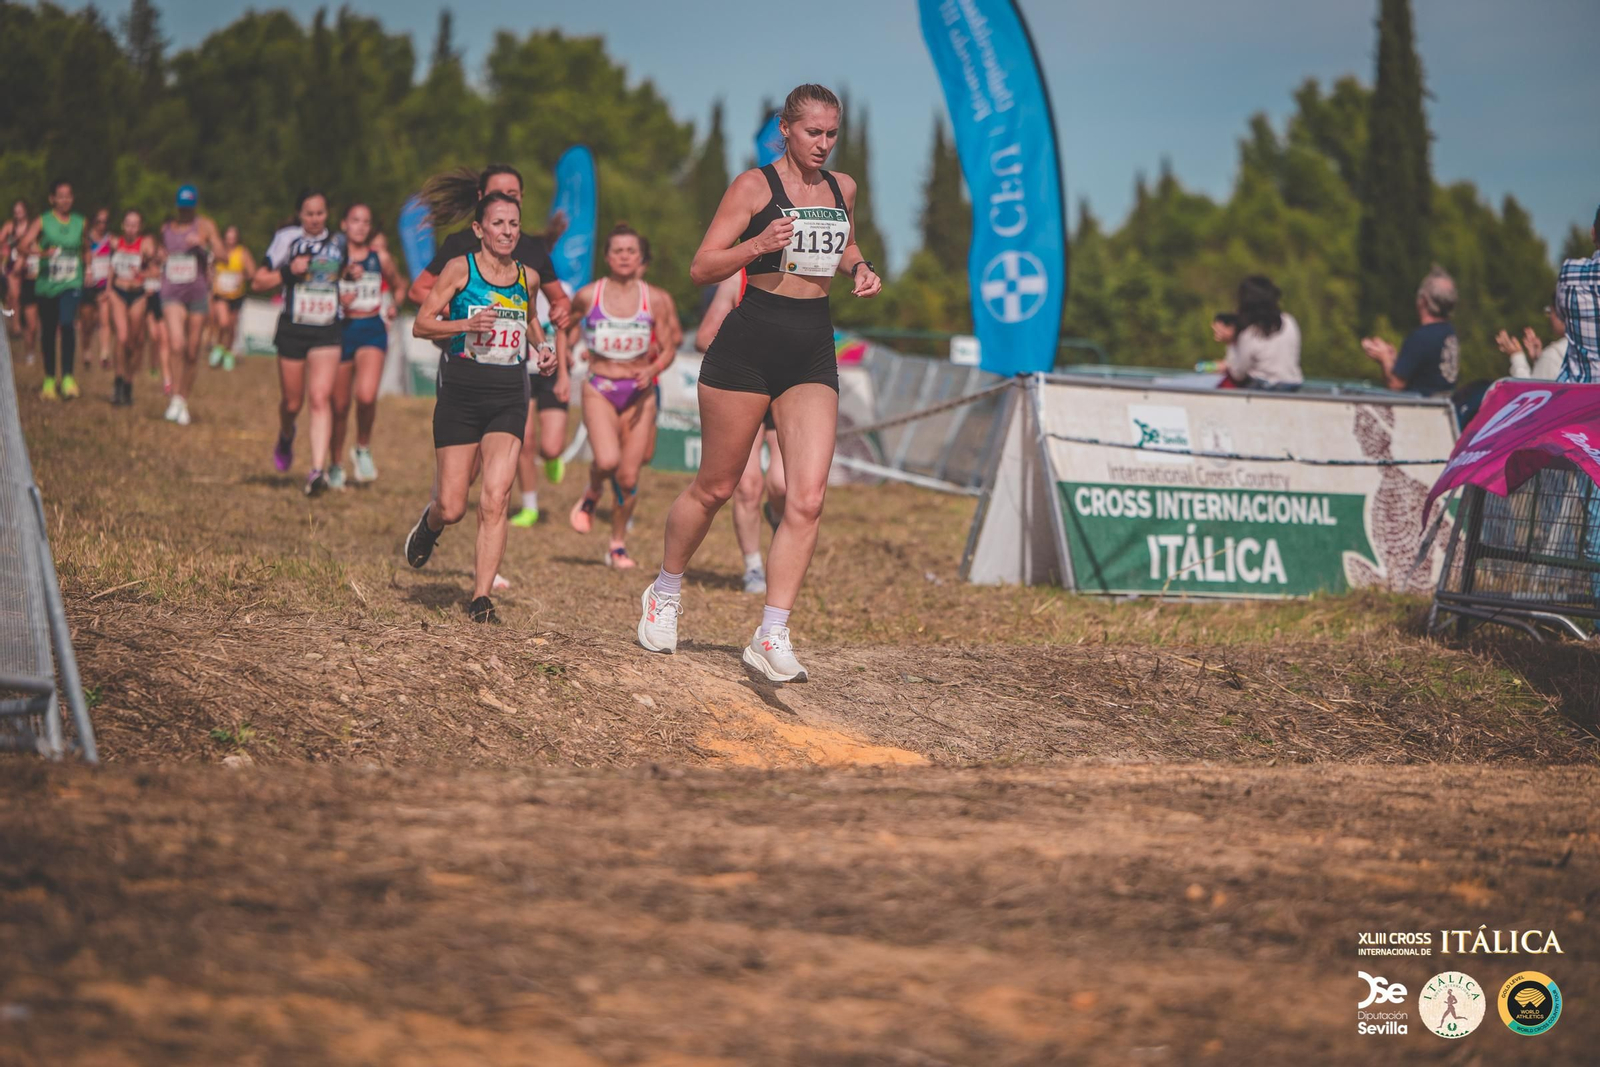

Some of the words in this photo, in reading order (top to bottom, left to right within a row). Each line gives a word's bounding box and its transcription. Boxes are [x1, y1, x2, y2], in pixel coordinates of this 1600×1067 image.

[792, 230, 846, 255] 1132
[472, 329, 521, 349] 1218
[603, 337, 644, 352] 1423
[1107, 461, 1195, 485] International
[1195, 465, 1234, 487] Cross
[1235, 467, 1291, 491] Country
[1074, 486, 1153, 518] CROSS
[1155, 490, 1338, 526] INTERNACIONAL
[1146, 522, 1288, 584] ITÁLICA
